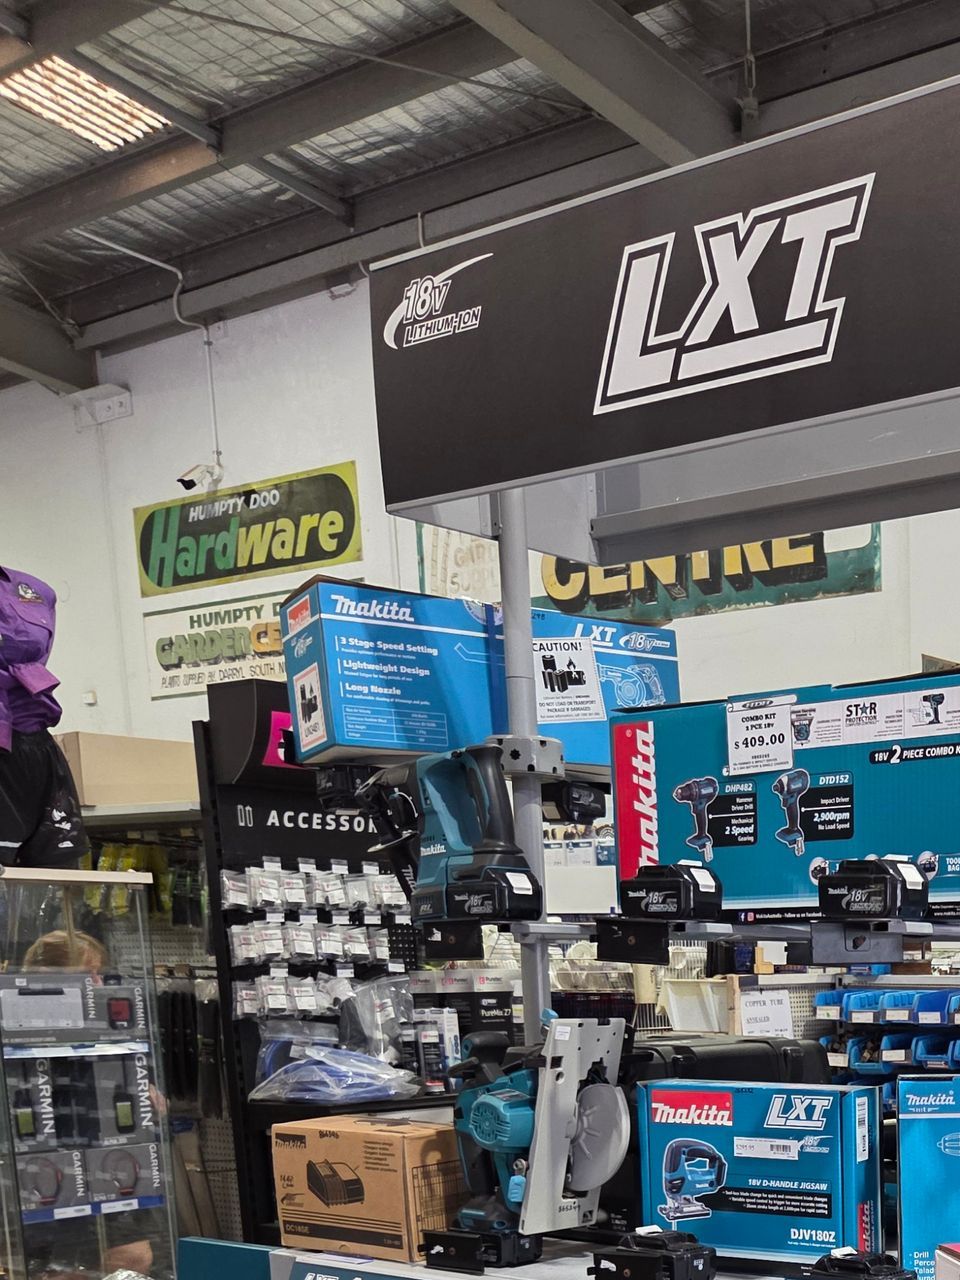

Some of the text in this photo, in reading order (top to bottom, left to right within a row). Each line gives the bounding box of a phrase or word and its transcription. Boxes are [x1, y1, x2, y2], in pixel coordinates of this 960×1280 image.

[593, 172, 876, 415] LXT
[403, 305, 482, 348] LITHIUM-ION
[188, 489, 280, 523] HUMPTY DOO
[147, 502, 344, 588] Hardware
[189, 604, 264, 629] HUMPTY
[574, 623, 617, 647] LXT
[341, 636, 438, 656] 3 Stage Speed Setting
[344, 660, 397, 673] Lightweight
[399, 664, 430, 677] Design
[346, 682, 401, 695] Long Nozzle
[741, 712, 776, 723] COMBO KIT
[742, 733, 785, 749] 409.00
[874, 752, 889, 762] 18V
[889, 744, 901, 764] 2
[902, 748, 924, 760] PIECE
[925, 746, 954, 758] COMBO
[725, 783, 753, 793] DHP482
[819, 774, 849, 785] DTD152
[820, 796, 850, 805] Impact Driver
[813, 811, 850, 823] 2,900rpm
[731, 825, 754, 837] Speed
[945, 857, 960, 865] TOOL
[947, 864, 960, 872] BAG
[134, 987, 146, 1029] GARMIN
[35, 1058, 55, 1136] GARMIN
[135, 1052, 153, 1129] GARMIN
[764, 1094, 833, 1130] LXT
[72, 1151, 85, 1197] GARMIN
[148, 1143, 160, 1188] GARMIN
[762, 1179, 798, 1188] D-HANDLE
[799, 1182, 828, 1190] JIGSAW
[790, 1228, 836, 1242] DJV180Z
[913, 1251, 929, 1259] Drill
